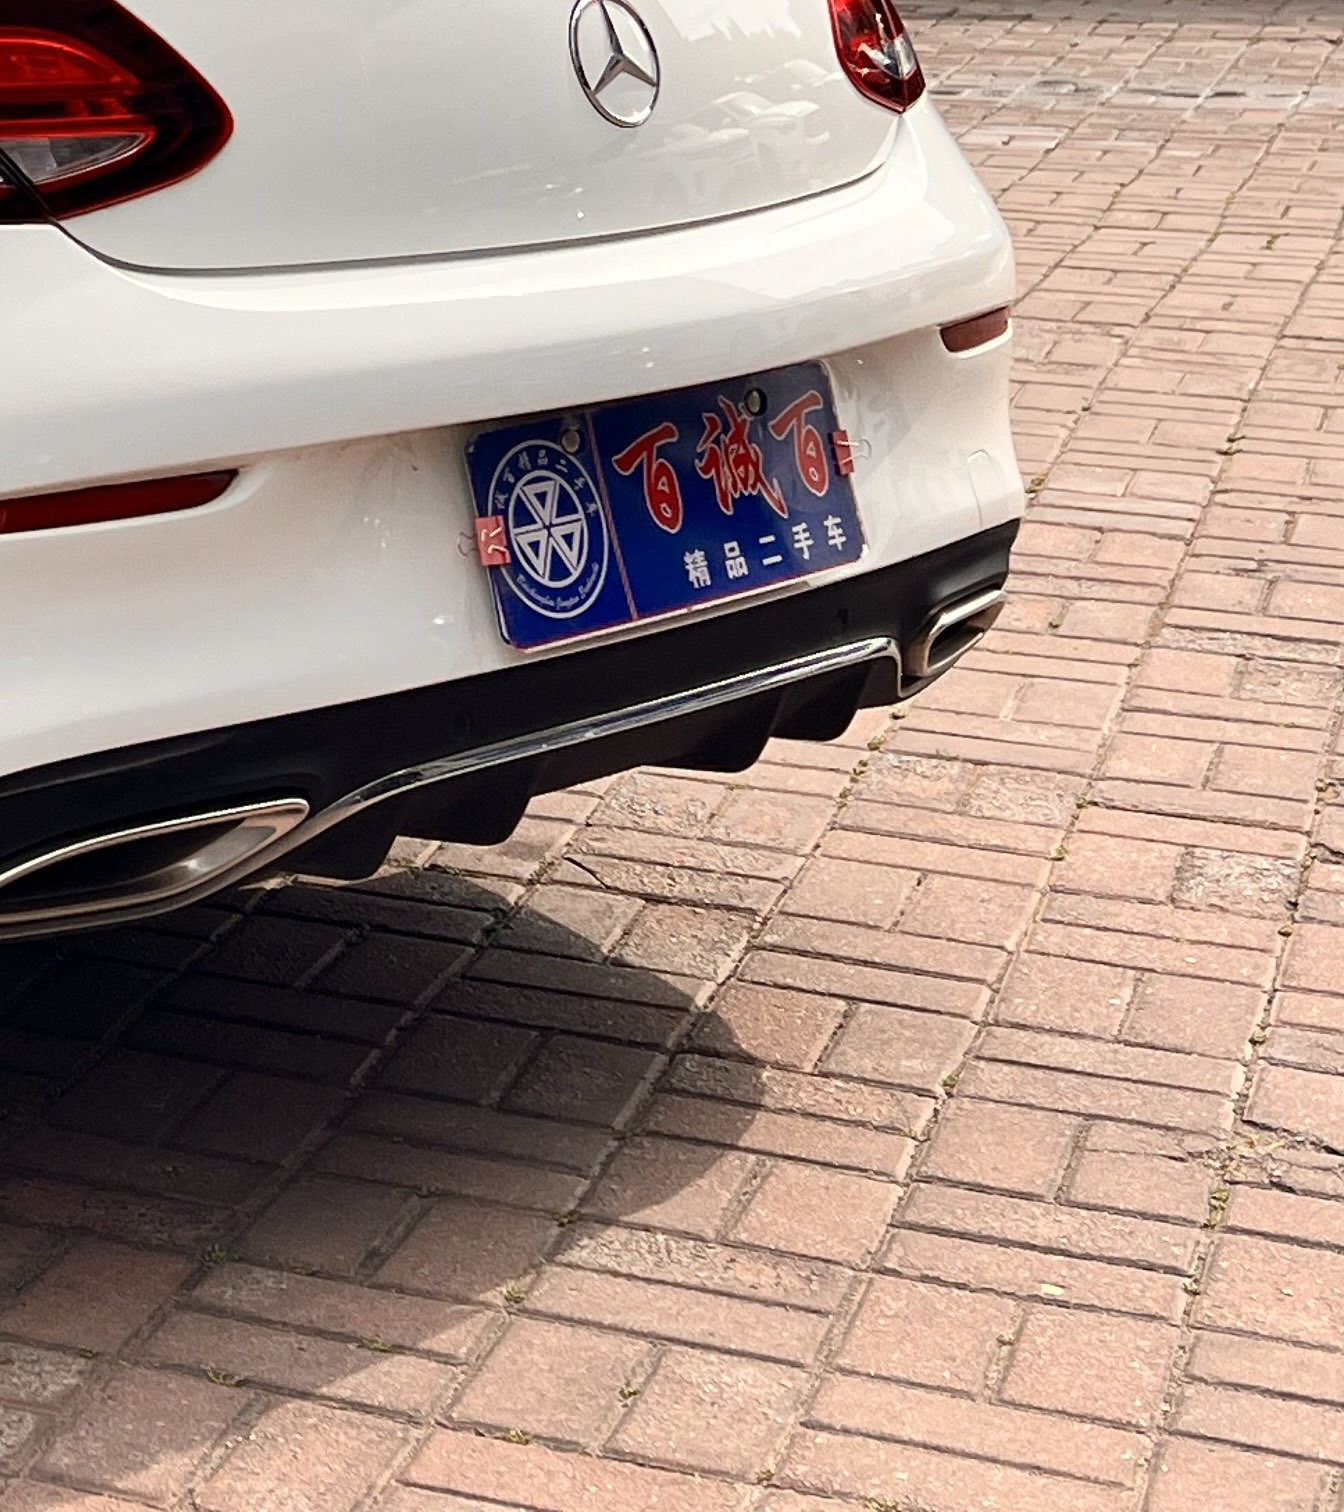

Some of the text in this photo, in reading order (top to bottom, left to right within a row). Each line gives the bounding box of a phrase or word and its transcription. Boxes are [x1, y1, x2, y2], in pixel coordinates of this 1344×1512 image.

[684, 514, 848, 589] 精品二手车
